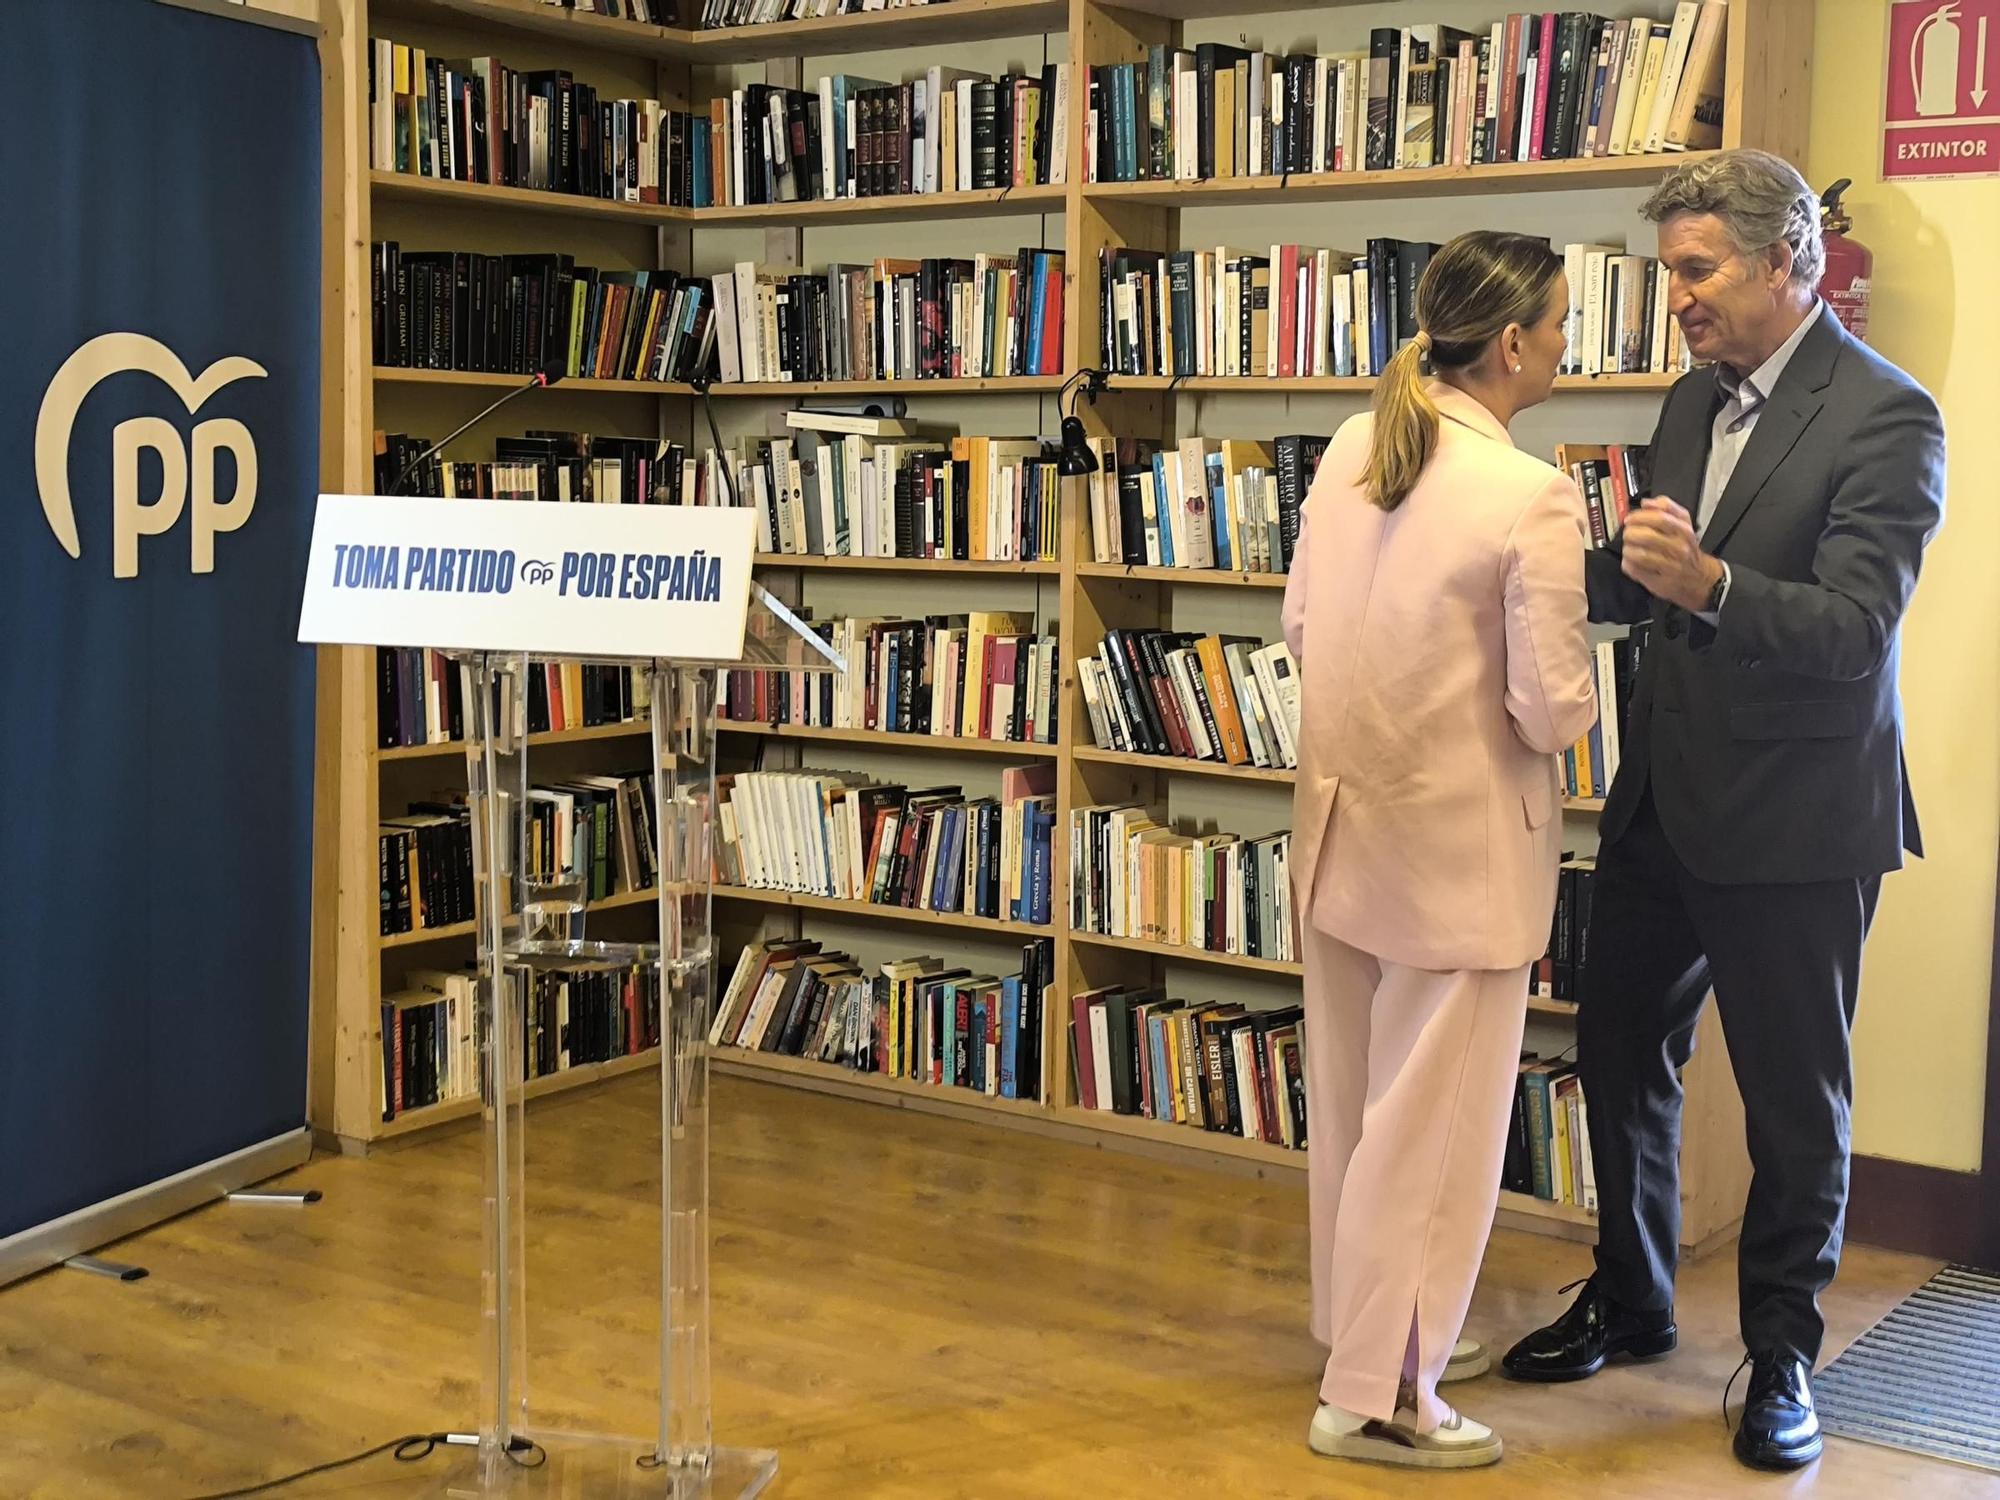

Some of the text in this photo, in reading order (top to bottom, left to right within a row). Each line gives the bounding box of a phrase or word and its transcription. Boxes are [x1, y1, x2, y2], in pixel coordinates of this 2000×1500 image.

[1897, 139, 1987, 160] EXTINTOR
[398, 270, 406, 295] JOHN
[1283, 445, 1295, 503] ARTURO
[1281, 510, 1290, 551] FUEGO
[1289, 509, 1300, 536] LÍNEA
[332, 544, 398, 590] TOMA
[403, 546, 515, 594] PARTIDO
[558, 551, 615, 597] POR
[618, 549, 721, 602] ESPAÑA
[1032, 882, 1040, 910] Grecia
[956, 993, 968, 1030] ALERT
[1182, 1018, 1190, 1048] FRANCESCO
[1185, 1066, 1193, 1077] UN
[1208, 1045, 1222, 1080] EISLER
[1186, 1078, 1196, 1114] CAPITANO
